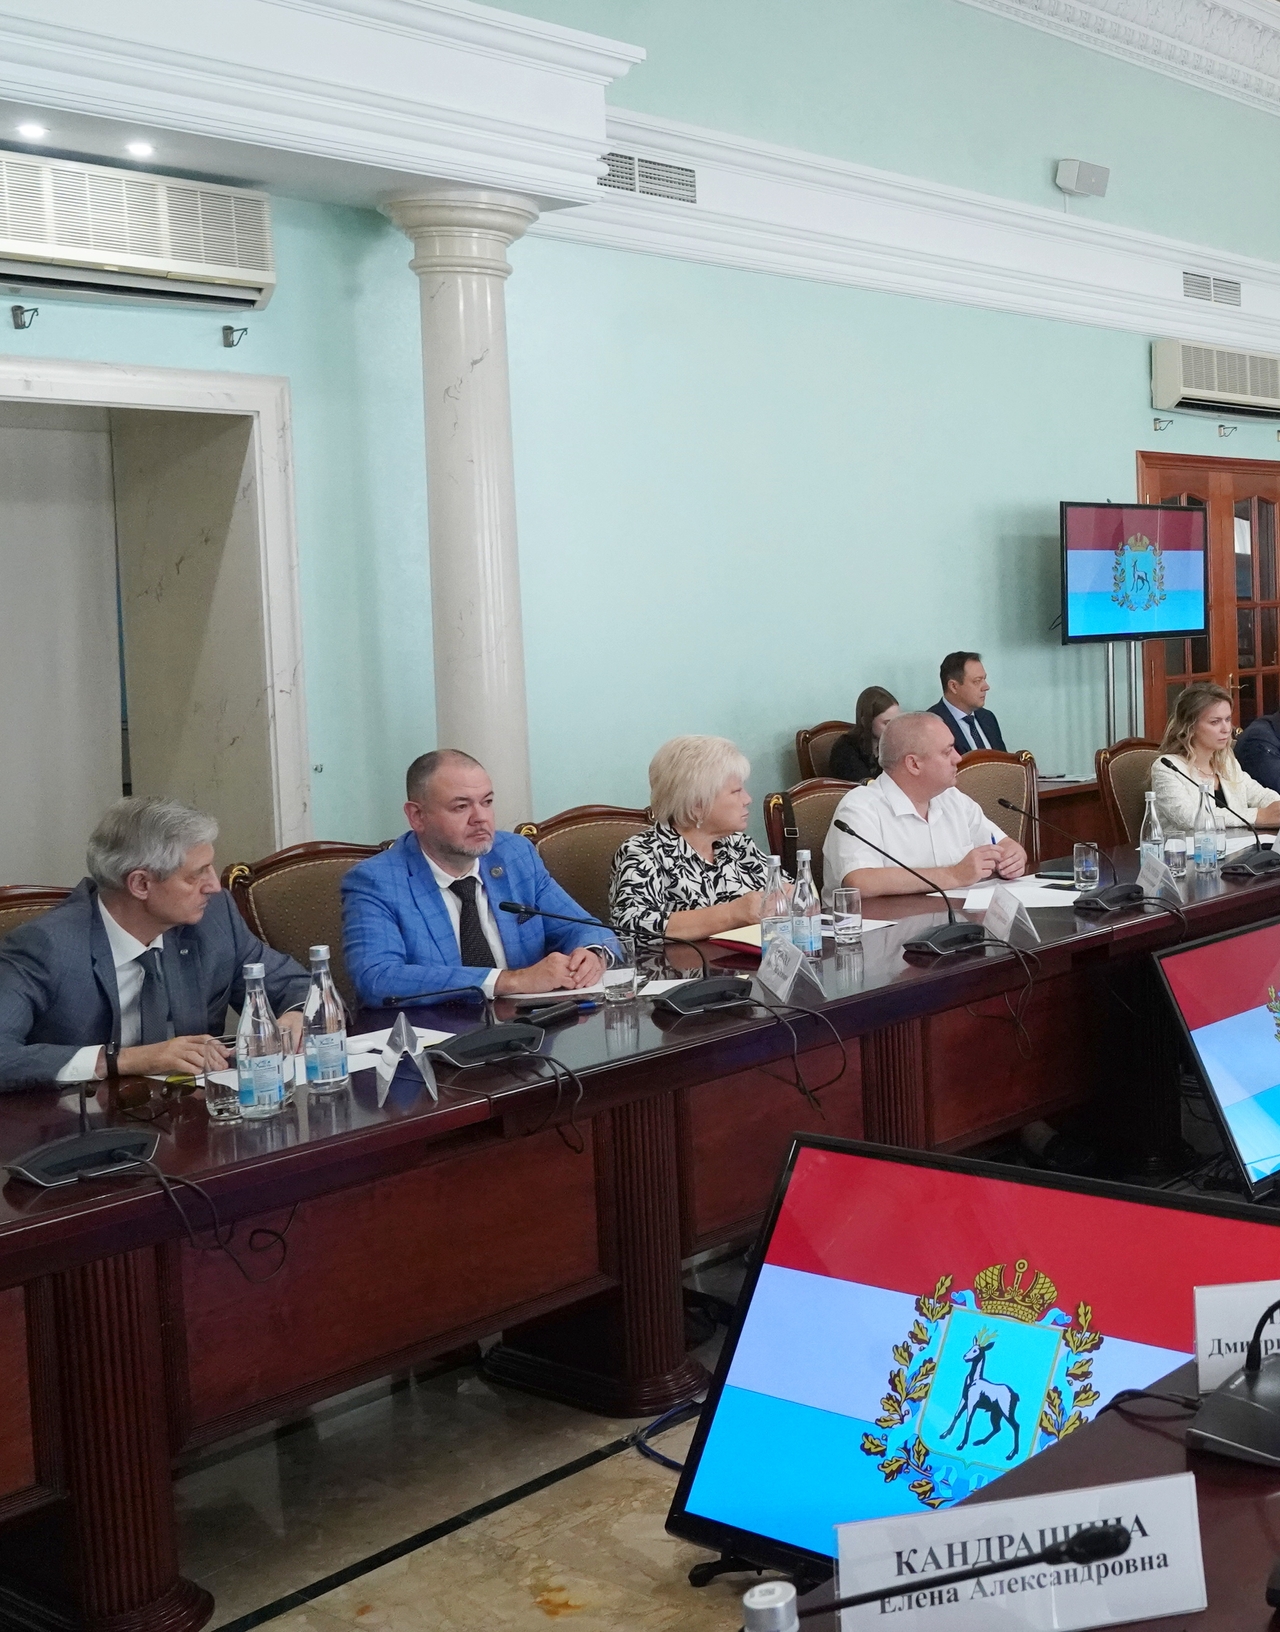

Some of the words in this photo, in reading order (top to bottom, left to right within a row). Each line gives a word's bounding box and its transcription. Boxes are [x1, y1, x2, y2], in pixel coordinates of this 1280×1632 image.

[894, 1513, 1150, 1577] КАНДРАША
[878, 1584, 960, 1616] Елена
[968, 1551, 1169, 1601] Александровна
